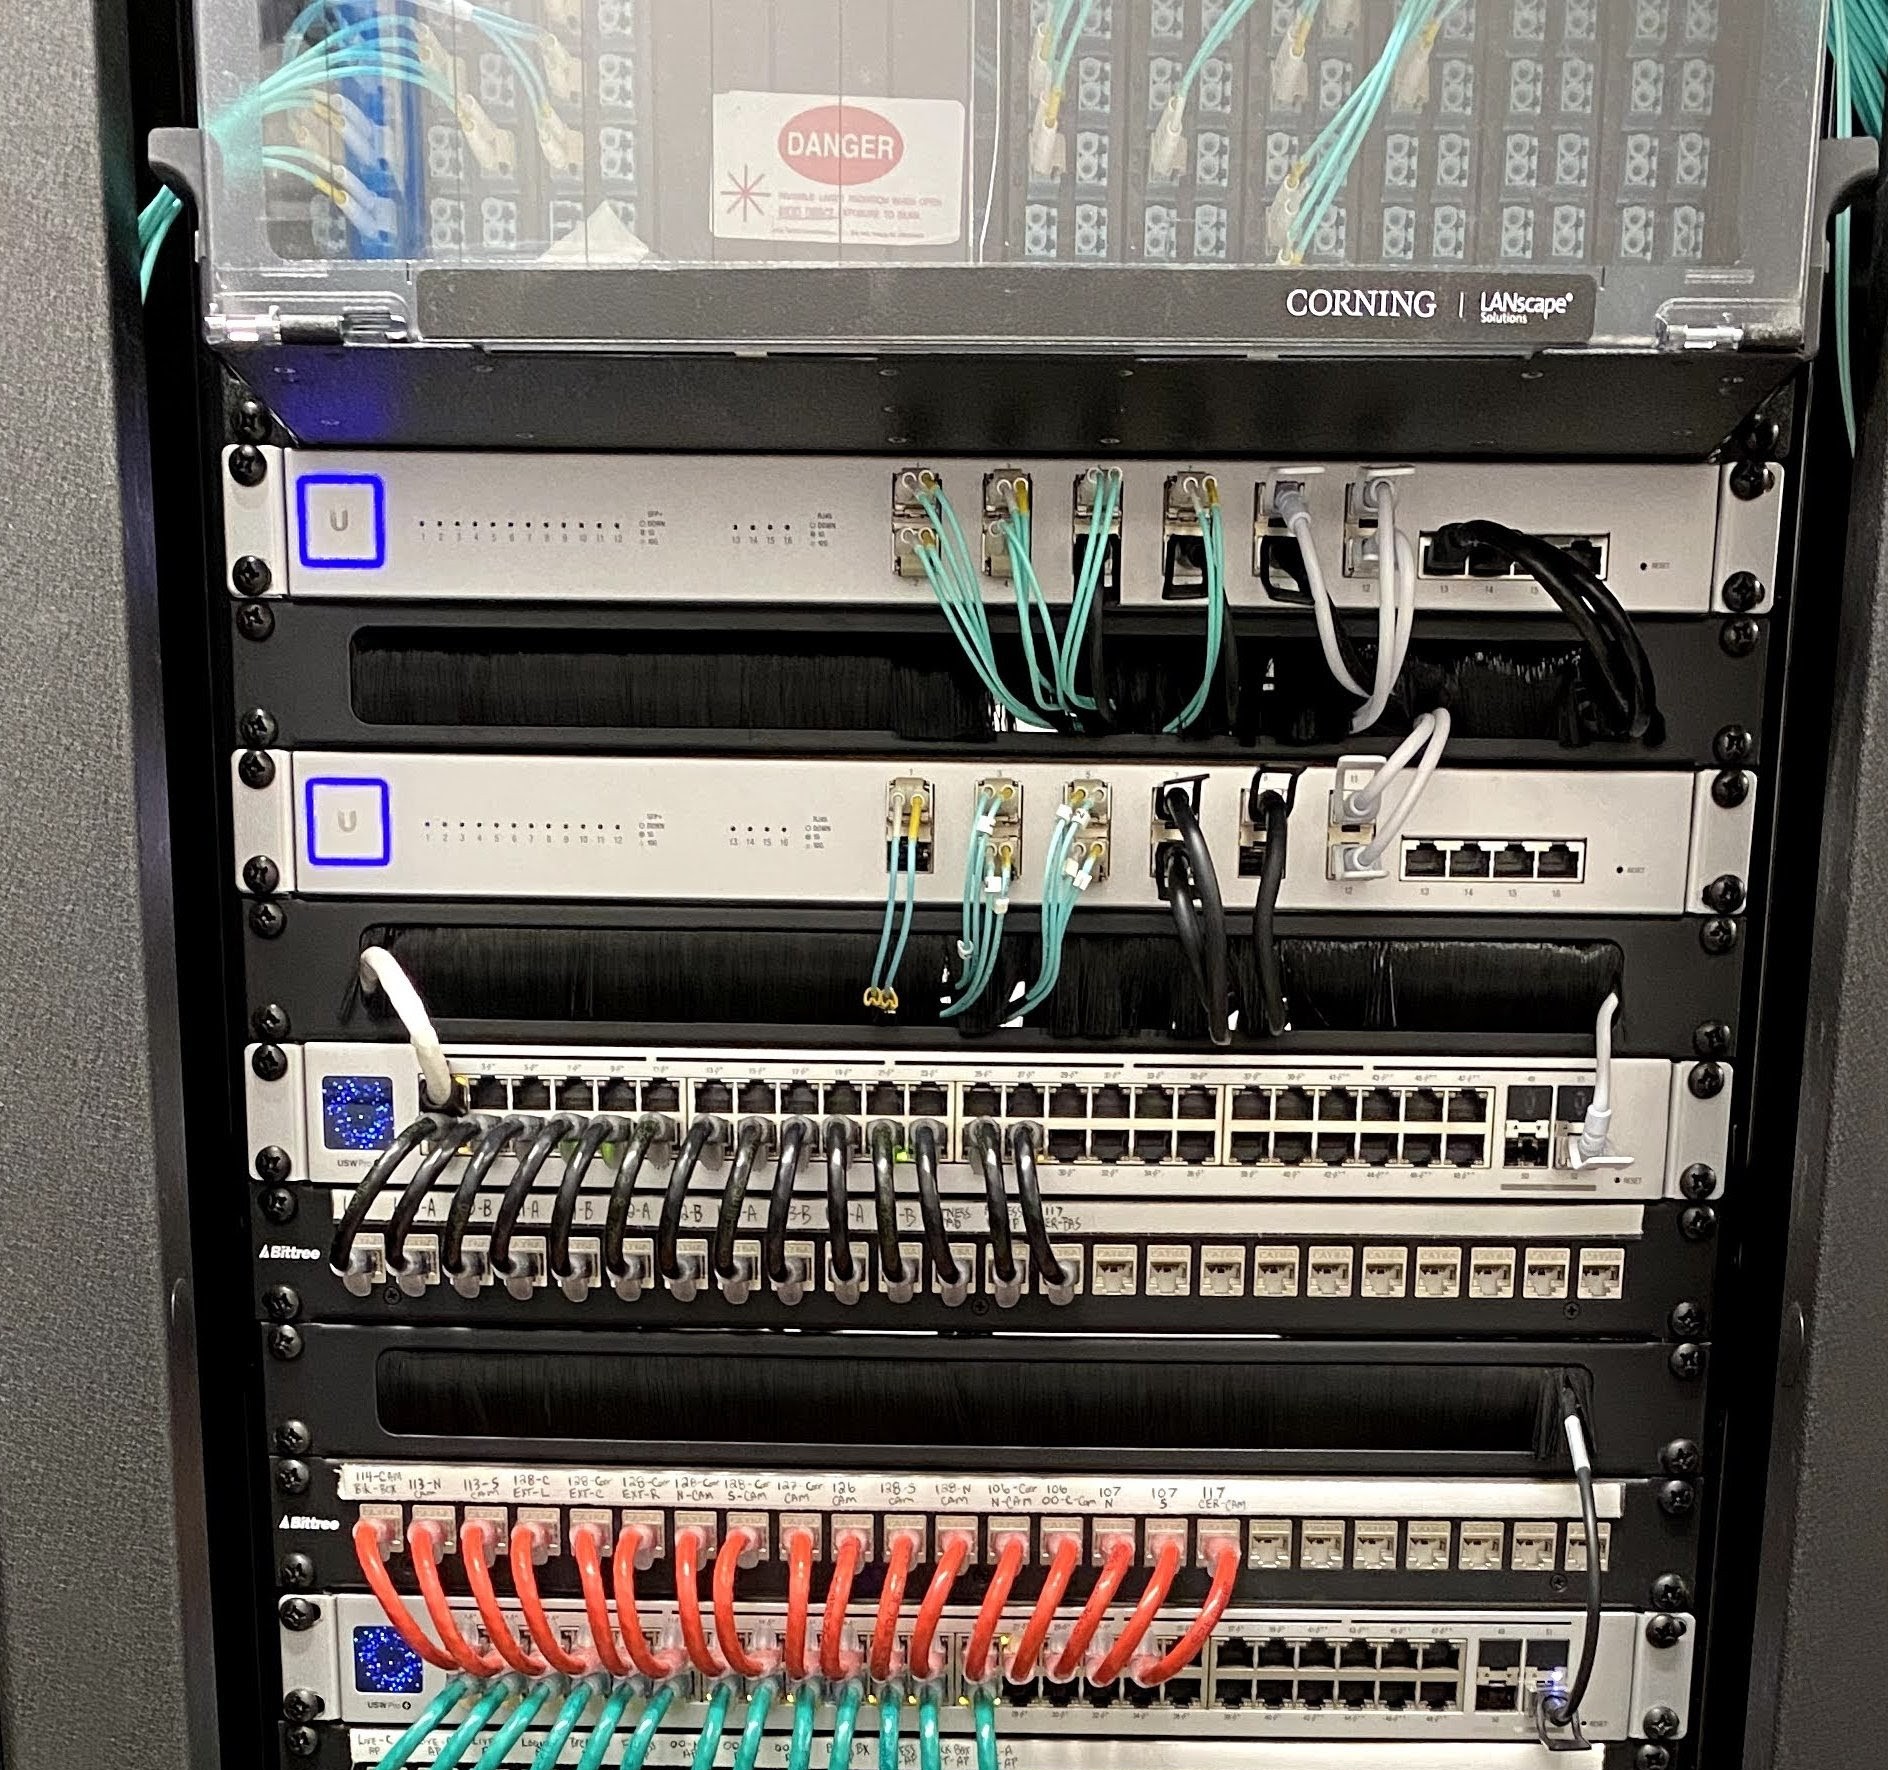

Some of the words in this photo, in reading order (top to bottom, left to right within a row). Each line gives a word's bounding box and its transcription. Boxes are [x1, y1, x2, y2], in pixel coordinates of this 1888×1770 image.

[786, 131, 894, 161] DANGER
[1286, 289, 1437, 318] CORNING
[1480, 312, 1528, 324] Solutions
[330, 509, 349, 532] U
[337, 809, 357, 832] U
[337, 1159, 357, 1168] USW
[270, 1245, 321, 1261] Bittree
[409, 1478, 441, 1489] 113-N
[464, 1477, 499, 1490] 113-S
[514, 1475, 550, 1485] 128-C
[513, 1488, 550, 1498] EXT-L
[833, 1482, 855, 1493] 126
[1047, 1484, 1067, 1494] 106
[1100, 1487, 1121, 1498] 107
[1152, 1488, 1178, 1498] 107
[1203, 1486, 1225, 1499] 117
[570, 1489, 604, 1499] EXT-C
[623, 1490, 660, 1499] EXT-R
[1105, 1499, 1113, 1508] N
[1160, 1499, 1167, 1509] S
[290, 1516, 340, 1531] Bittree
